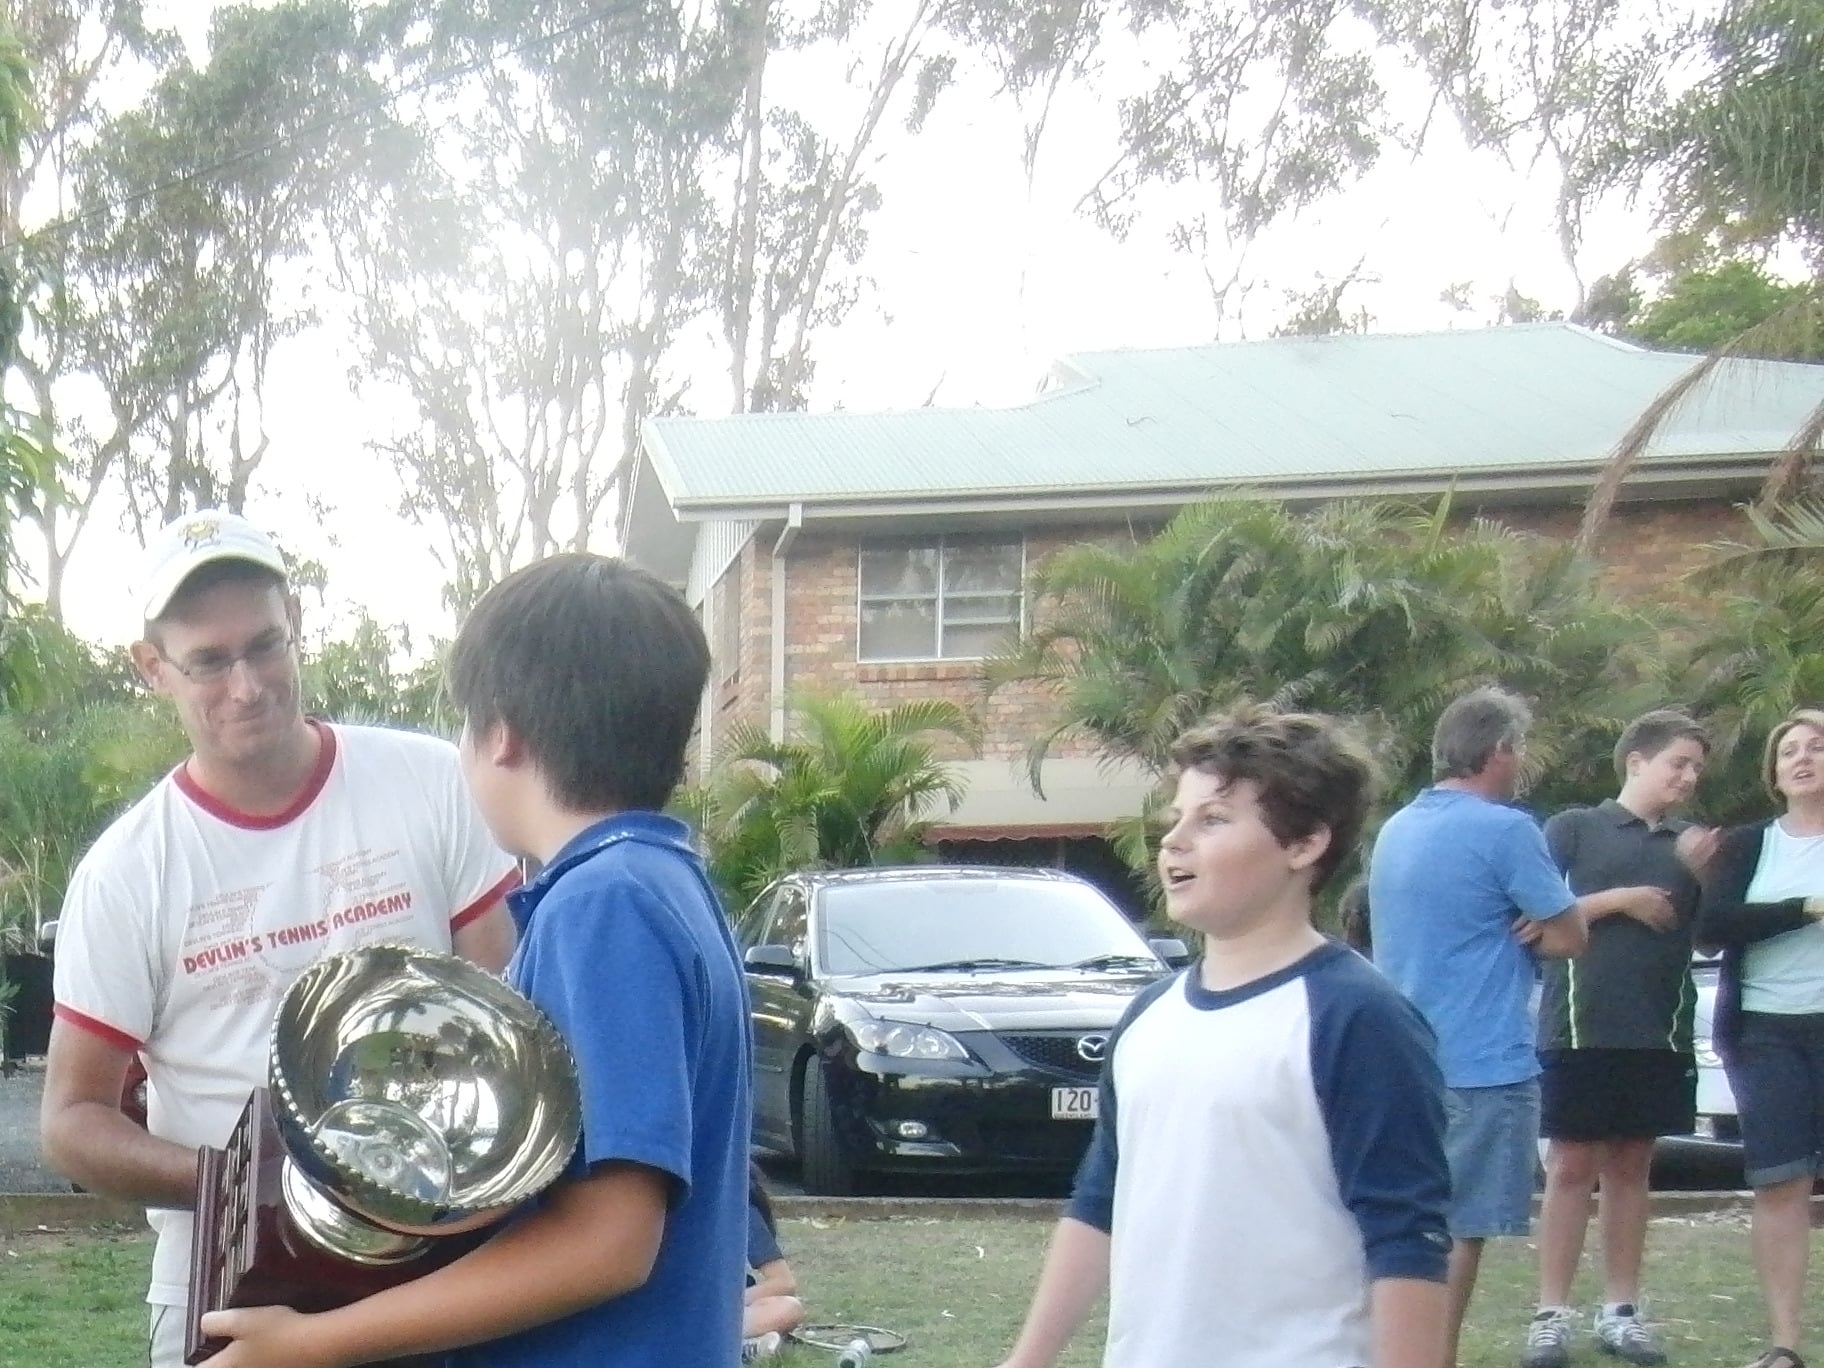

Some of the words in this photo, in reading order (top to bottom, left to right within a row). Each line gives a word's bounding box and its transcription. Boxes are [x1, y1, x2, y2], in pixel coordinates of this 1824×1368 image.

[183, 937, 263, 975] DEVLIN'S
[266, 921, 328, 949] TENNIS
[332, 892, 412, 930] ACADEMY
